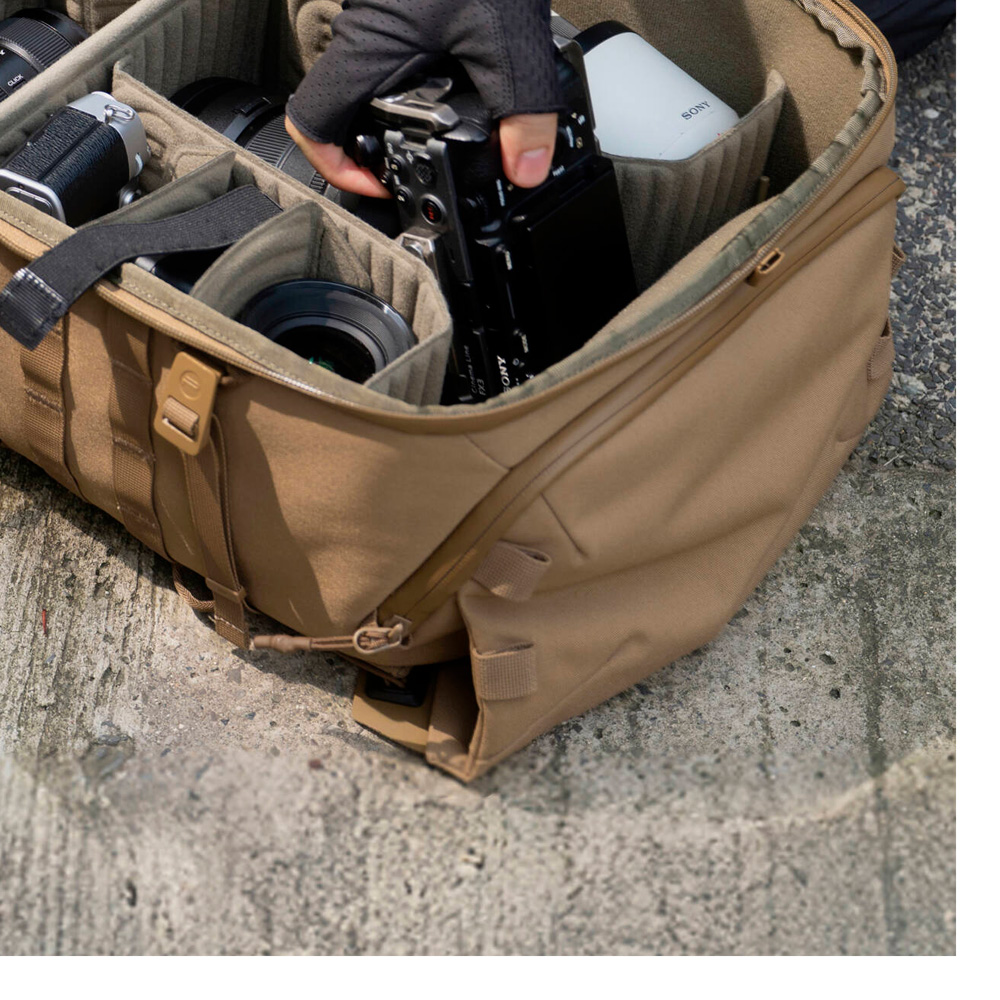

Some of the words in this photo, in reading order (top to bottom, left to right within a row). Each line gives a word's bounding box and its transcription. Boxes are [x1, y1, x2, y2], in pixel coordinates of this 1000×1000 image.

[7, 73, 24, 87] CLICK
[681, 100, 711, 121] SONY
[463, 344, 472, 363] Line
[468, 364, 478, 394] Cinema
[476, 378, 487, 396] FX3
